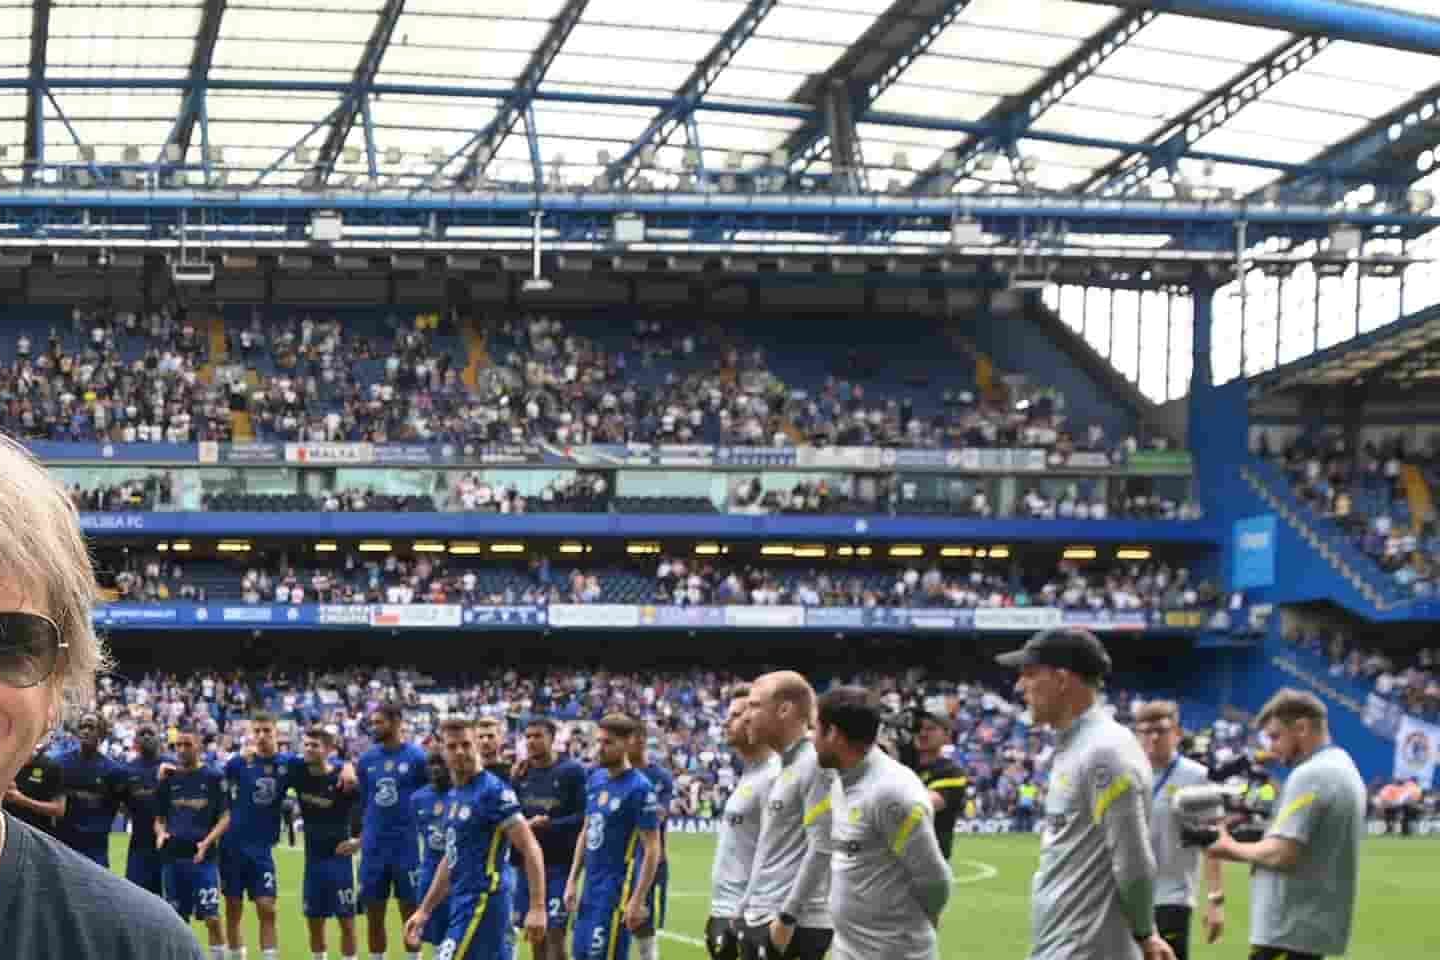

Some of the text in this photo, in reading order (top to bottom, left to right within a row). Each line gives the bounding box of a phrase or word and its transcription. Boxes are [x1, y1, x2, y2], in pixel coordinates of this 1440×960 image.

[199, 887, 220, 905] 22
[337, 888, 354, 905] 10
[591, 926, 605, 949] 5
